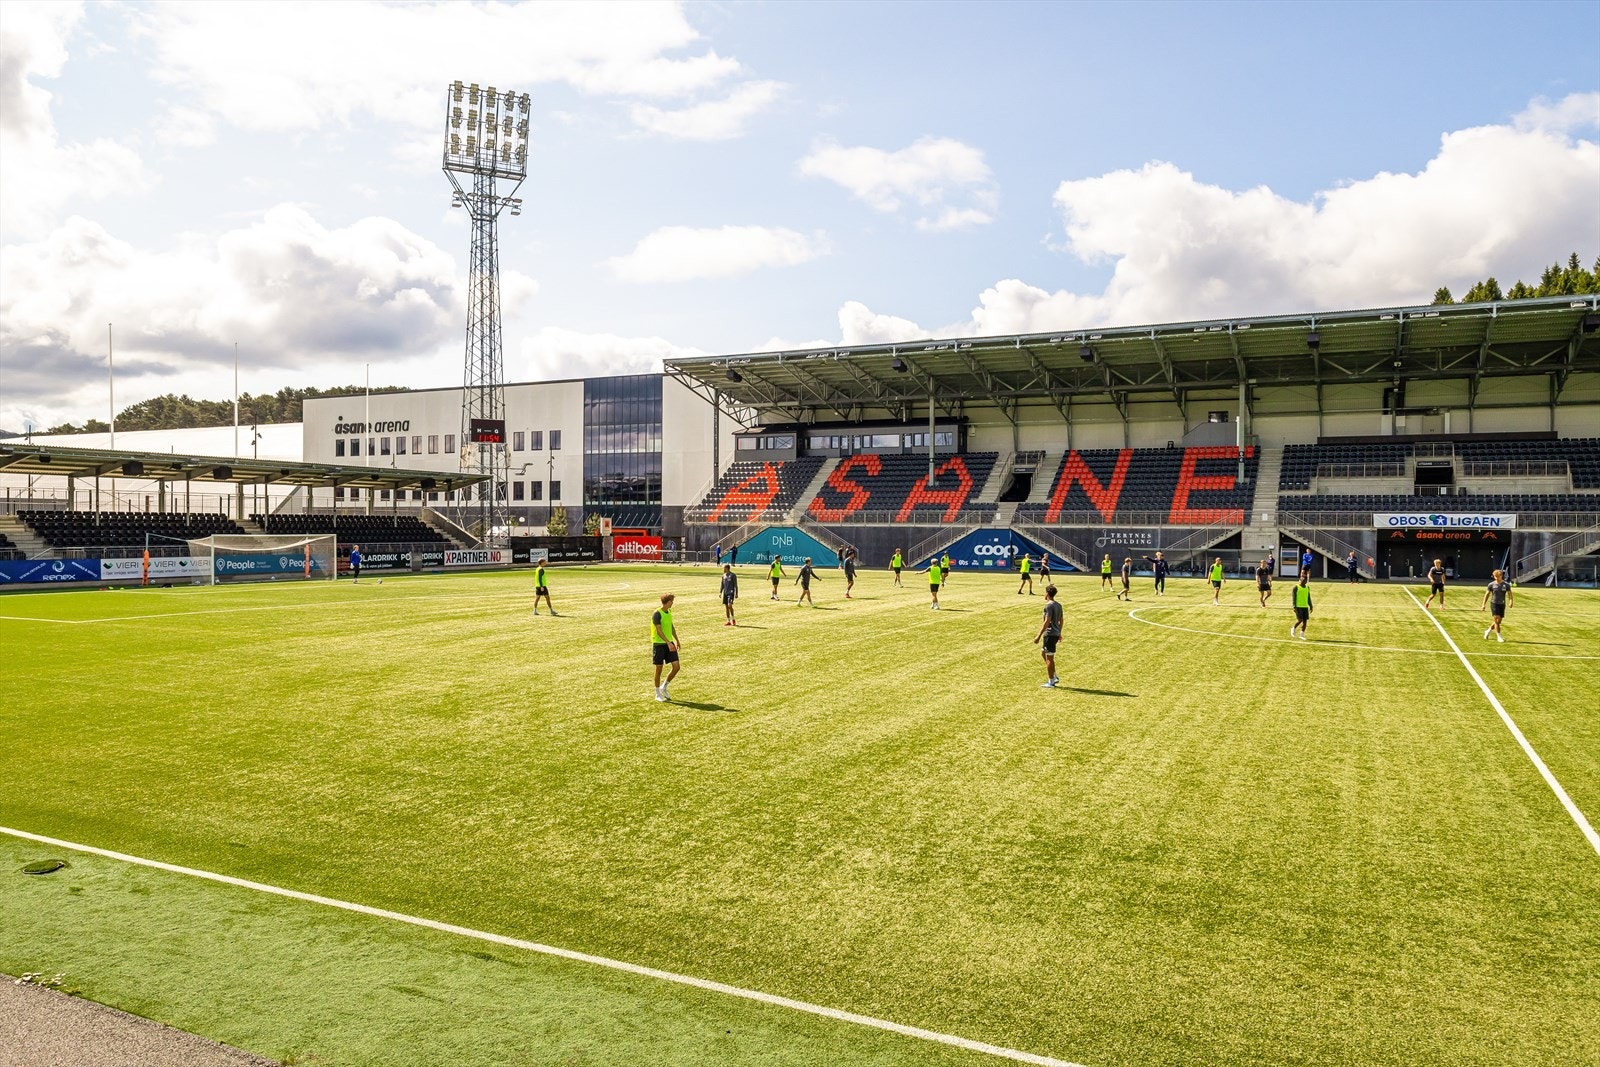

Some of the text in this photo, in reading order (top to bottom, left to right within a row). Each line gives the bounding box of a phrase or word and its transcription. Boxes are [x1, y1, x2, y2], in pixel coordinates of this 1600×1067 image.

[335, 416, 410, 434] åsane arena
[1388, 516, 1500, 527] OBOS LIGAEN
[1416, 530, 1471, 540] åsane arena
[772, 533, 793, 549] DNB
[616, 541, 658, 555] altibox
[973, 545, 1019, 558] coop
[445, 551, 501, 563] XPARTNER.NO
[115, 561, 139, 569] VIERI
[154, 560, 176, 568] VIERI
[226, 560, 255, 570] People
[288, 559, 314, 568] Peope
